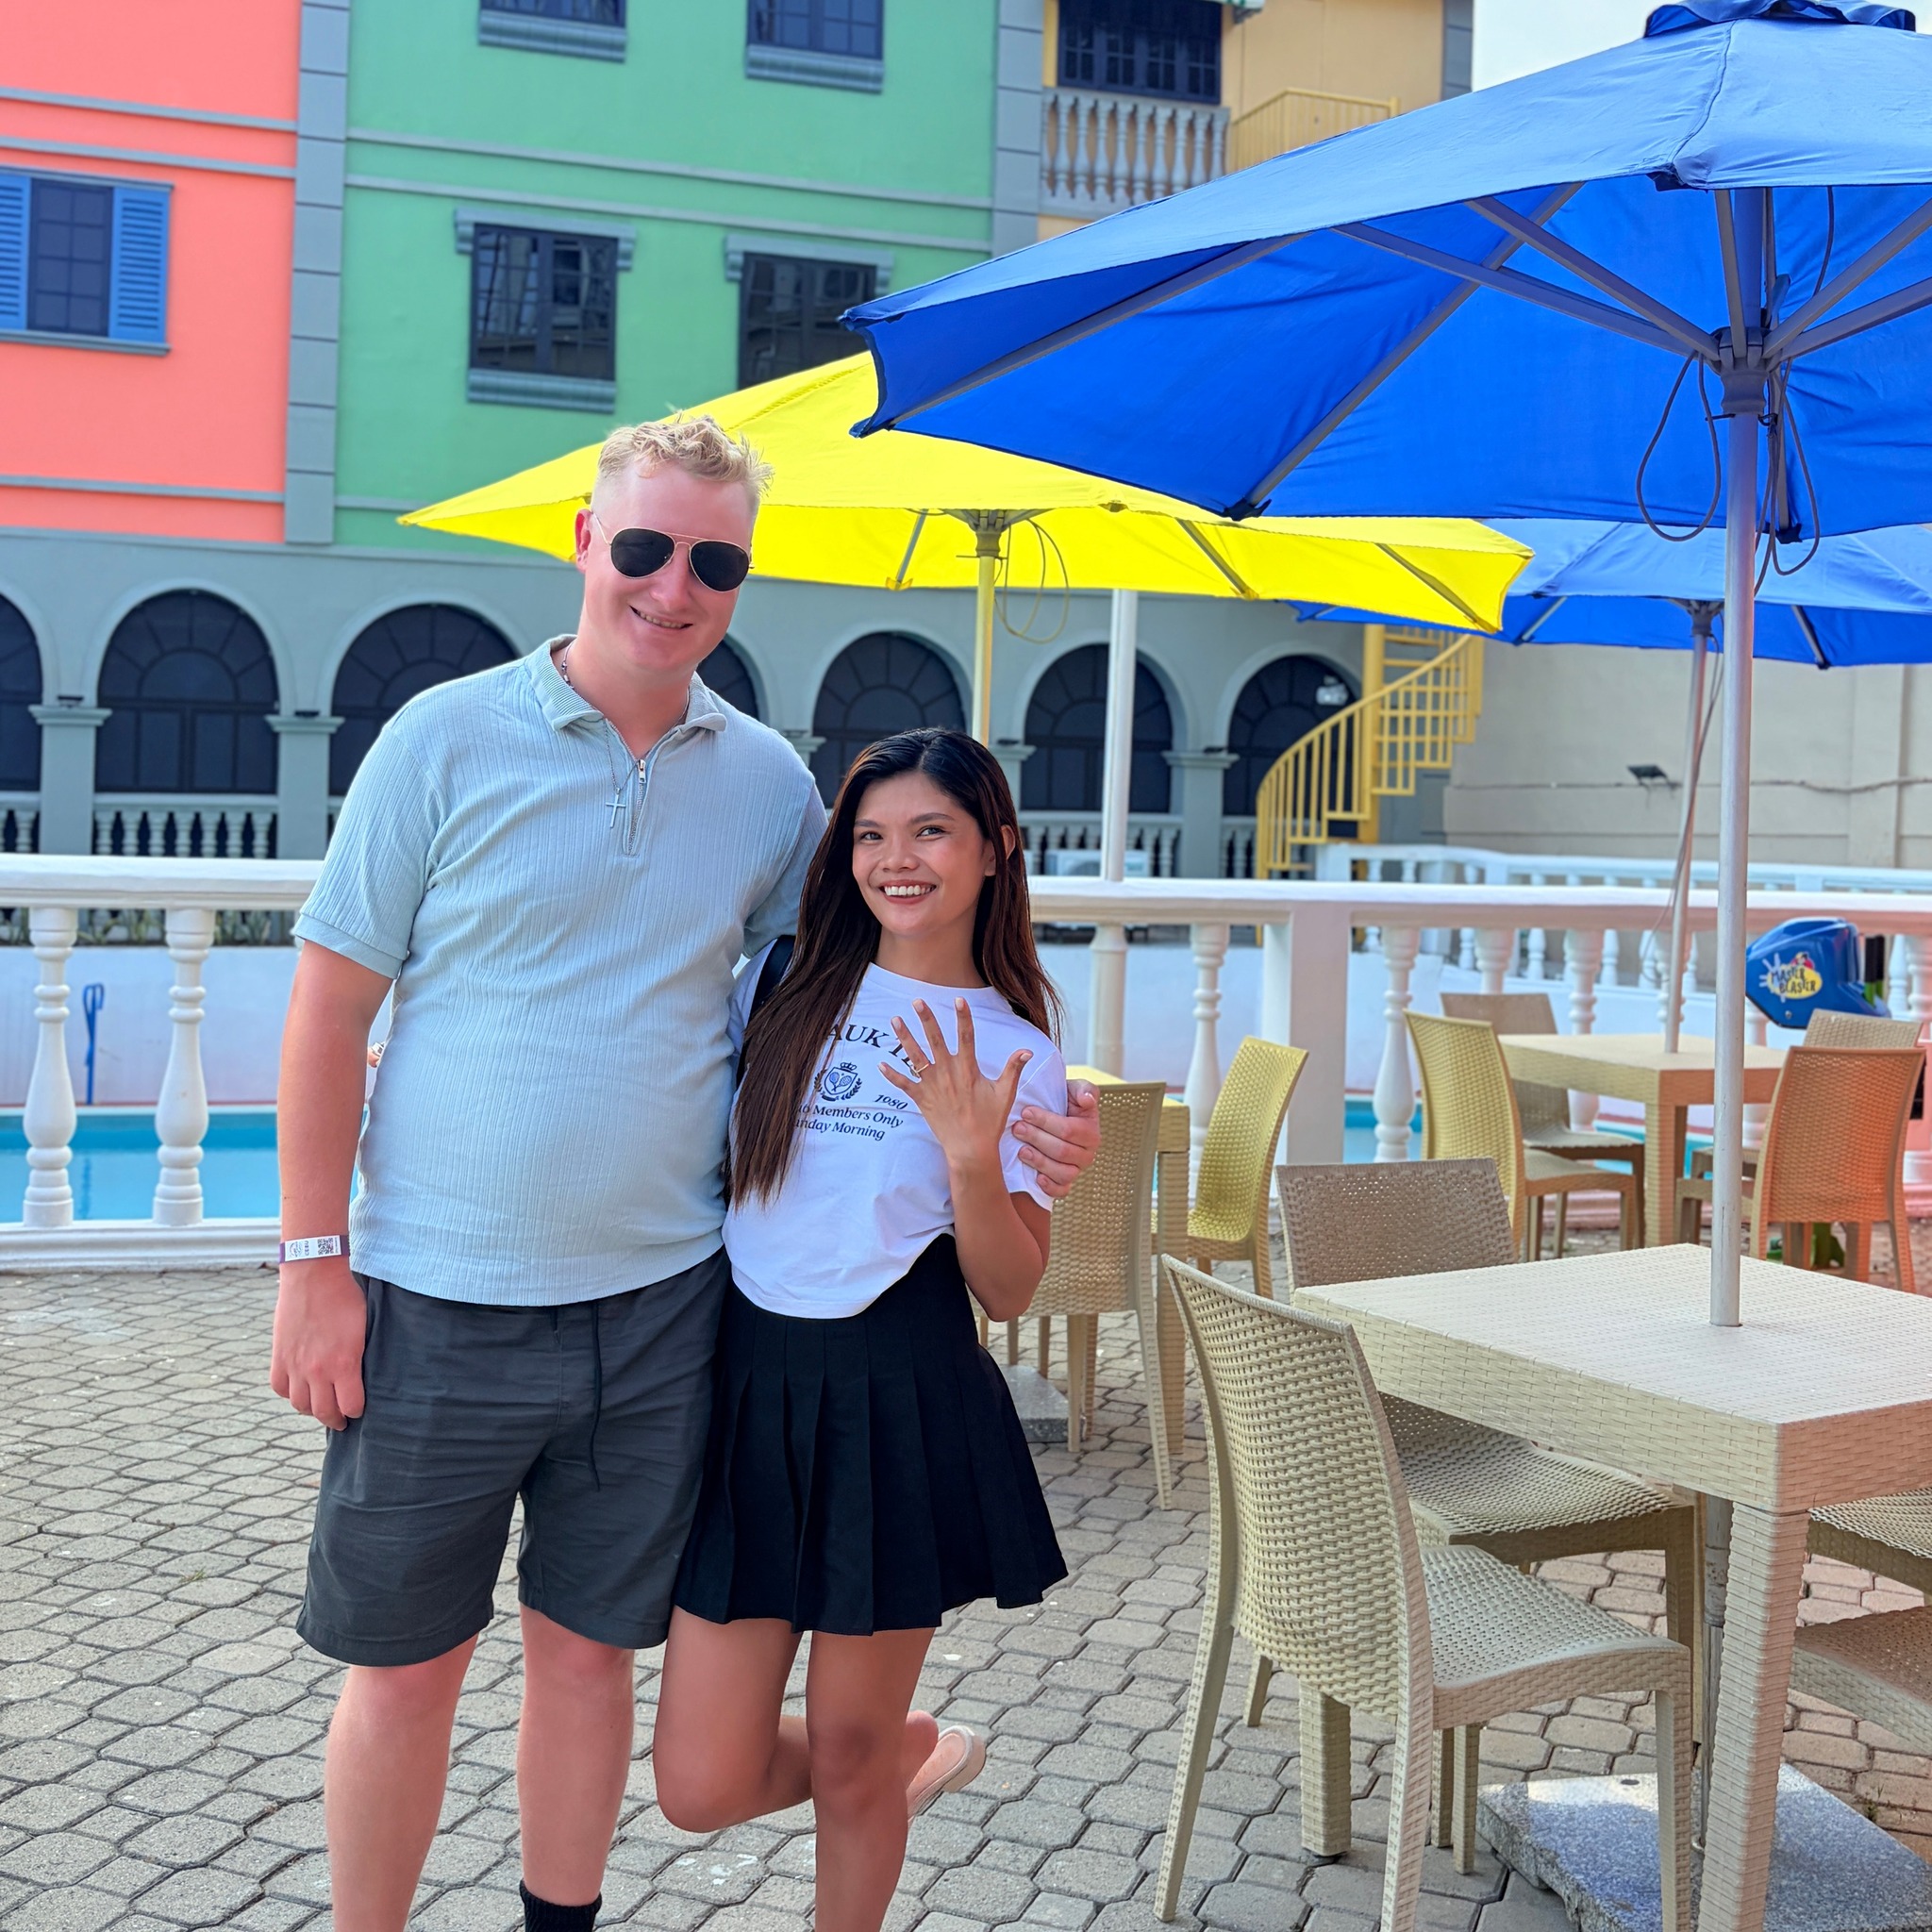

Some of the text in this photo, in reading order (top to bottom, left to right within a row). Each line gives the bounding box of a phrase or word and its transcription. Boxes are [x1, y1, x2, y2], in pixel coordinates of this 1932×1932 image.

[1778, 977, 1817, 994] BLASTER
[812, 1105, 872, 1121] Members
[873, 1111, 904, 1128] Only
[831, 1121, 886, 1141] Morning
